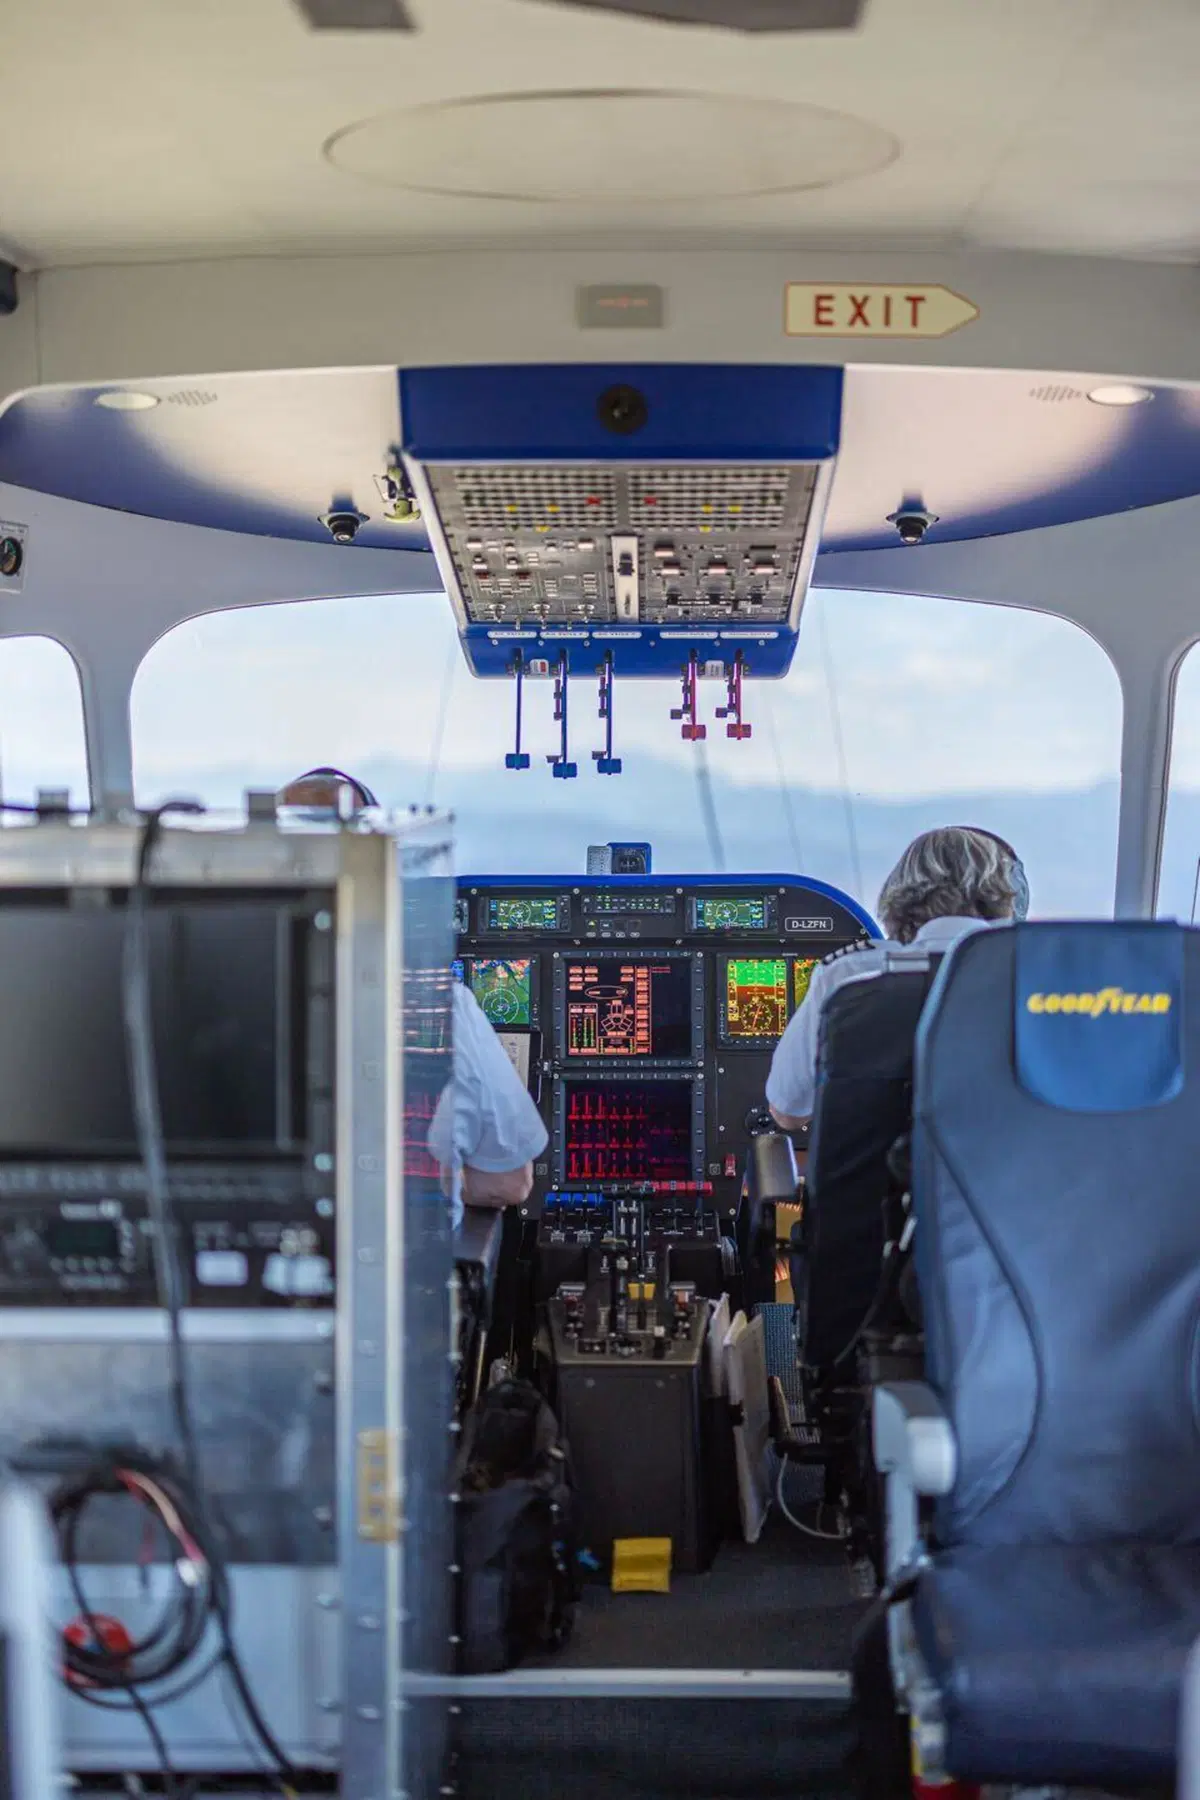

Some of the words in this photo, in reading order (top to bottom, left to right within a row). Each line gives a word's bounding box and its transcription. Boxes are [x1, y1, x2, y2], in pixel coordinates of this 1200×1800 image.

[814, 294, 926, 328] EXIT
[791, 920, 827, 929] D-LZFN
[1027, 987, 1172, 1018] GOODYEAR
